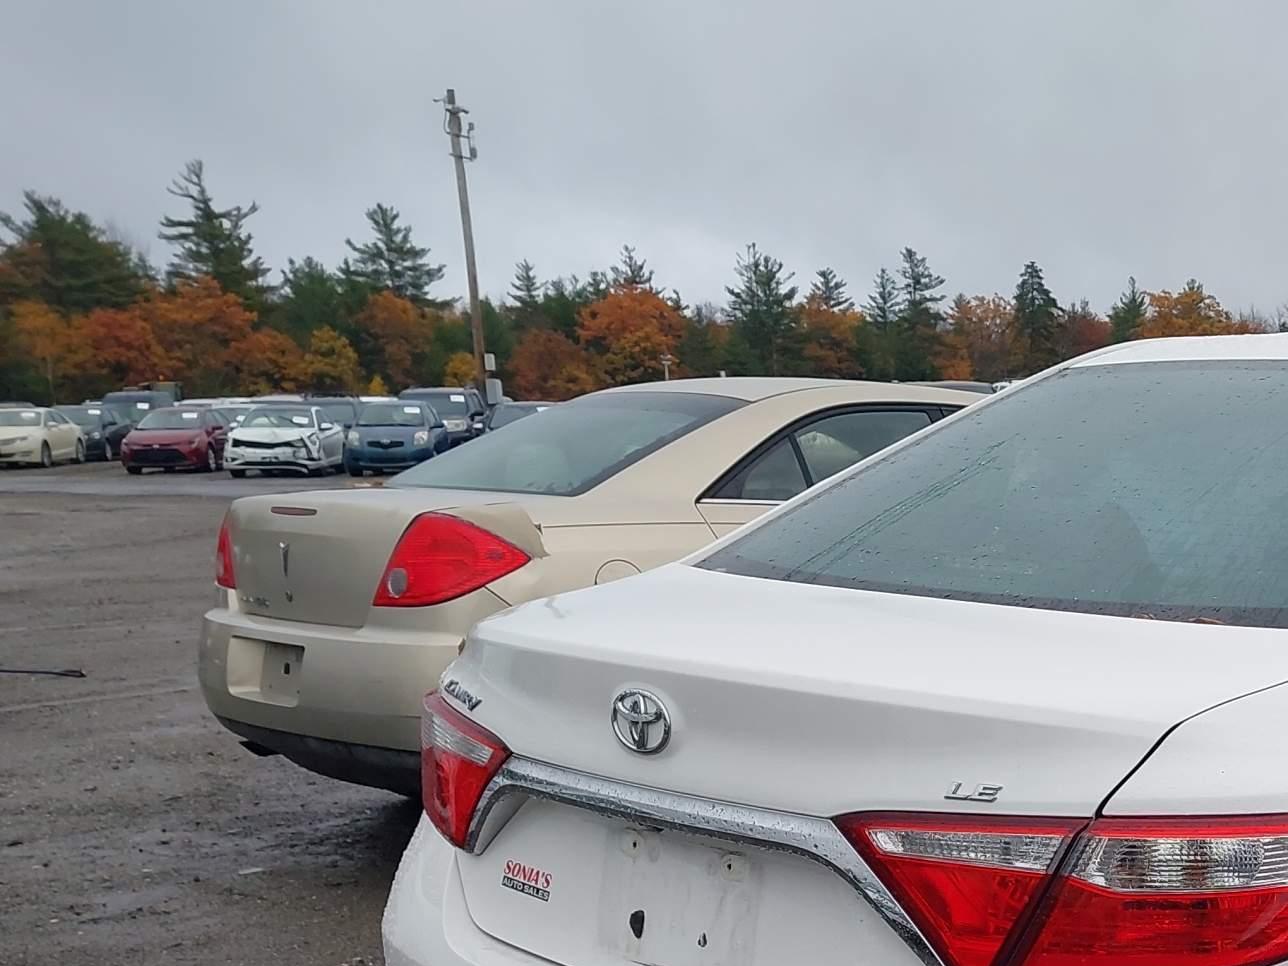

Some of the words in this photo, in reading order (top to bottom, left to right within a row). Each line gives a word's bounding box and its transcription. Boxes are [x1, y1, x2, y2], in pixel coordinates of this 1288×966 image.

[944, 781, 1003, 803] LE
[504, 859, 552, 889] SONIA'S
[502, 877, 523, 890] AUTO
[523, 885, 549, 900] SALES
